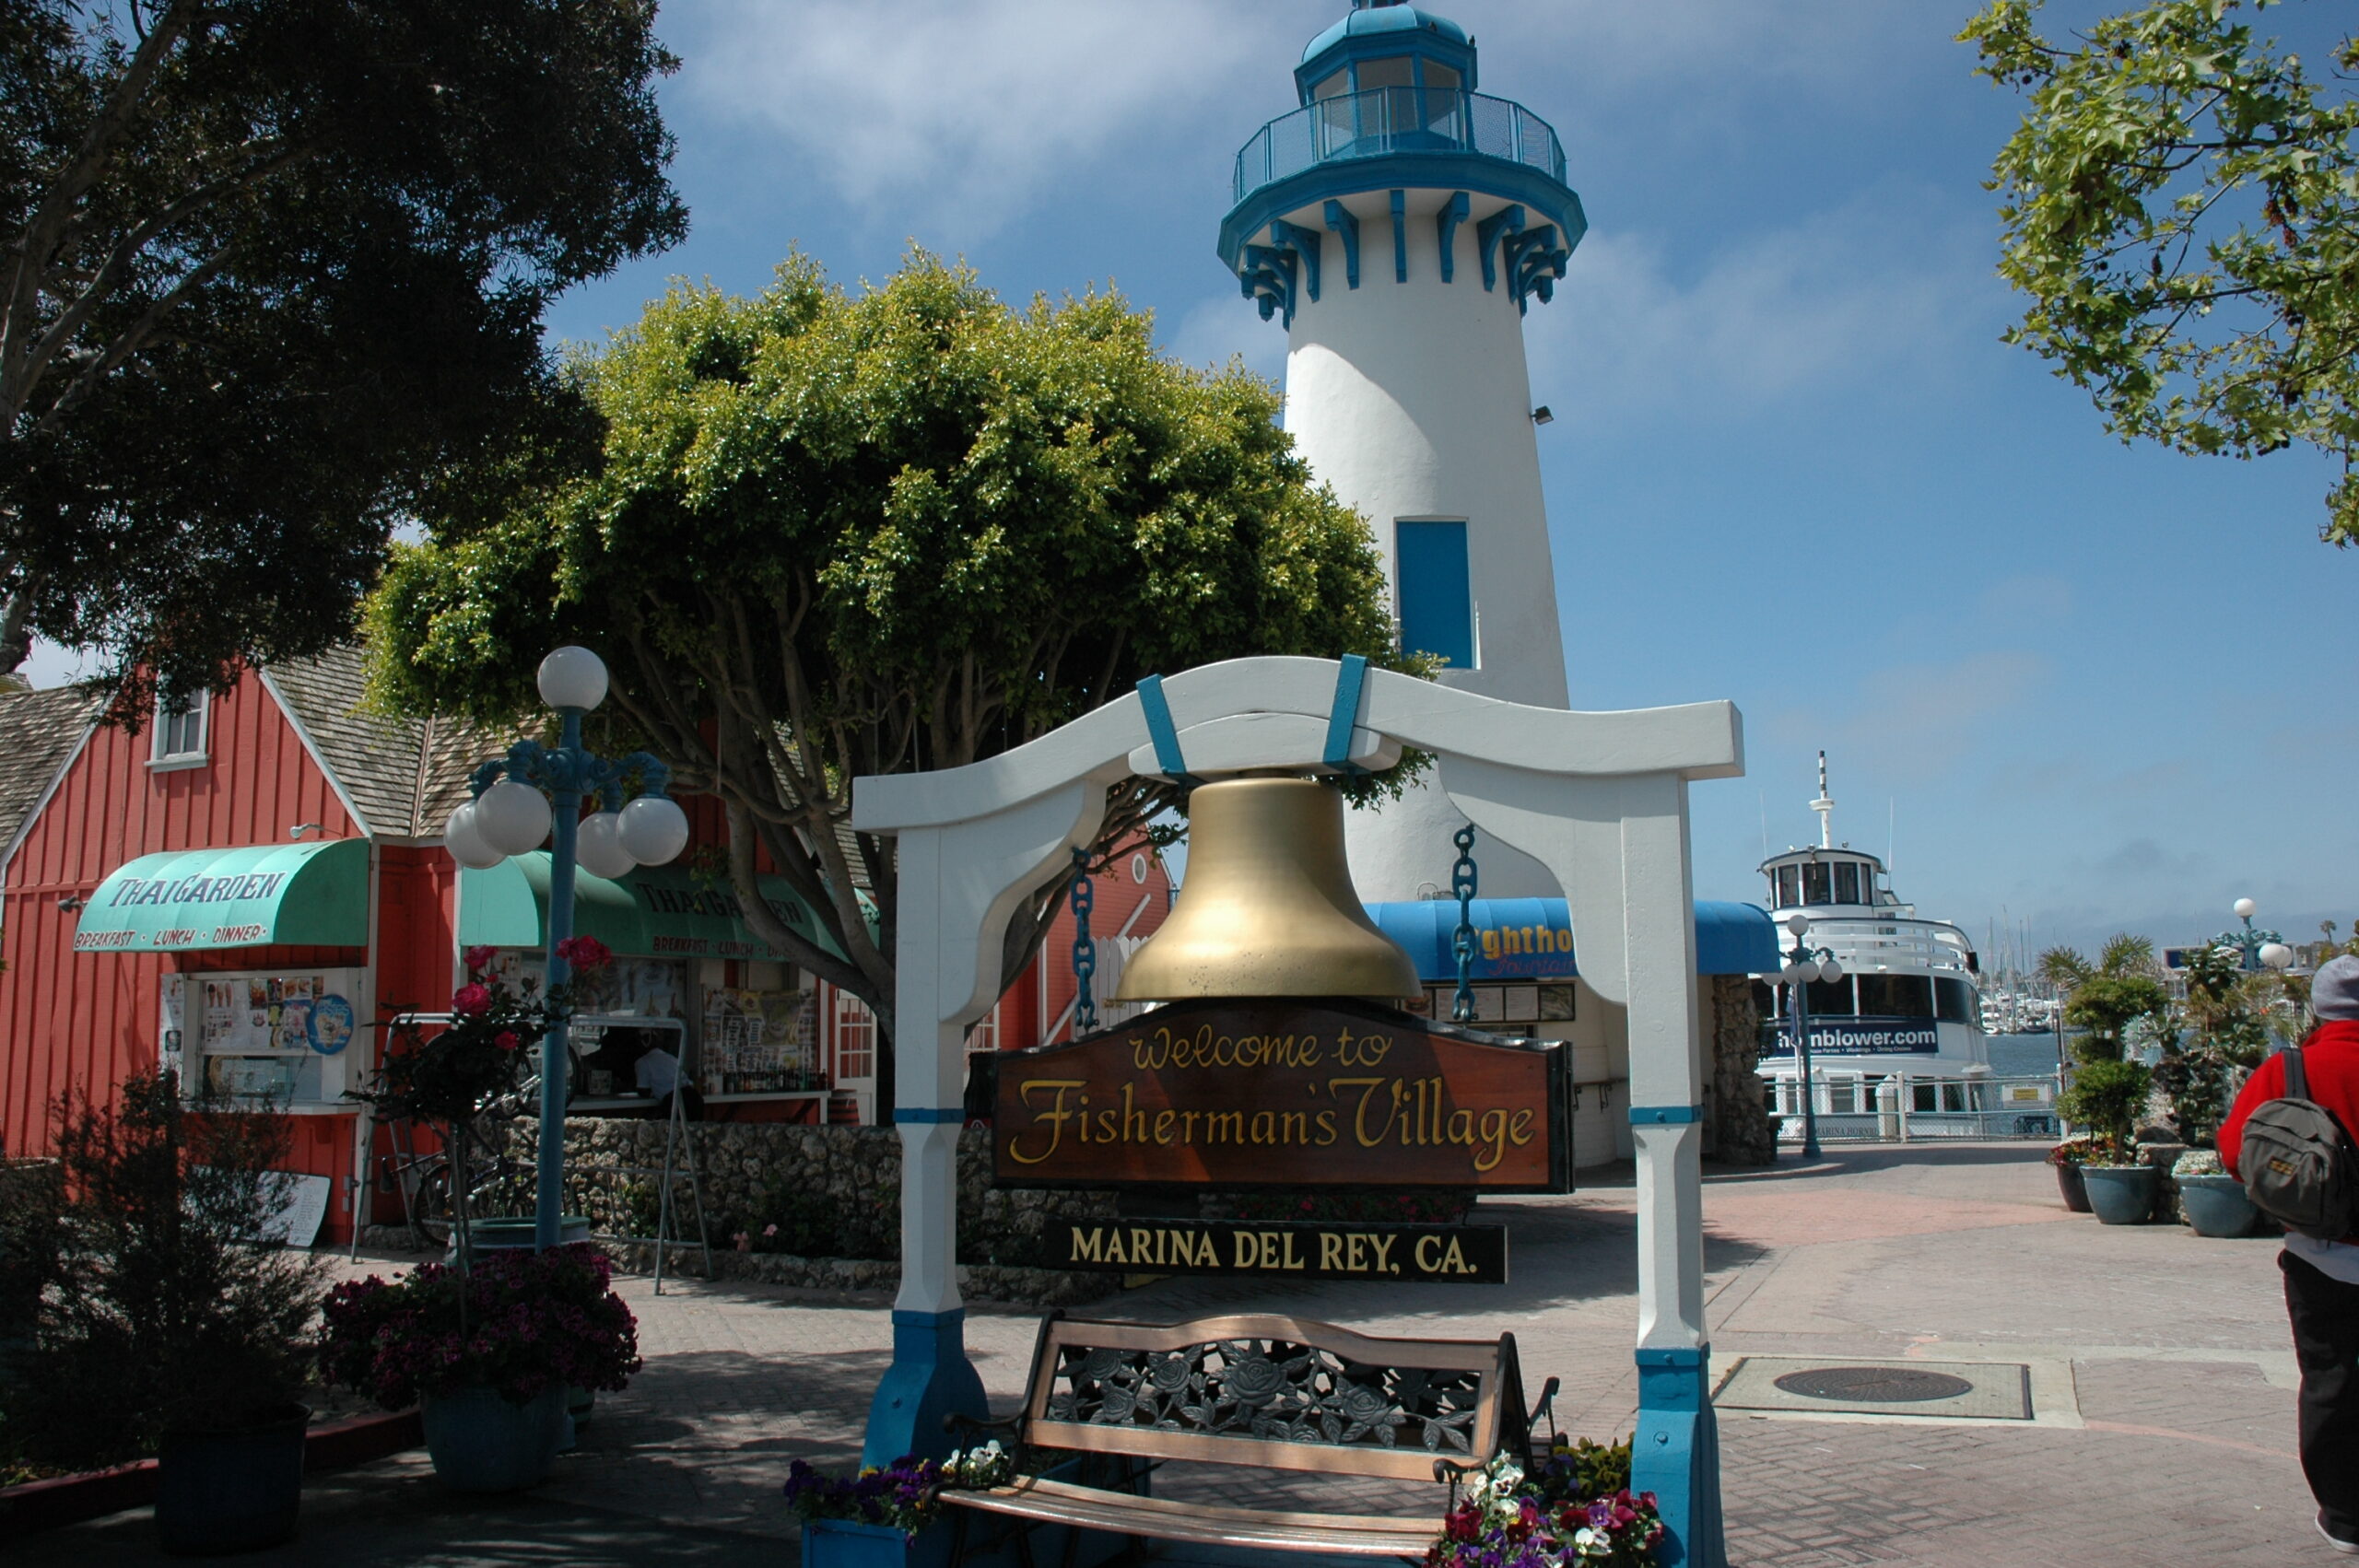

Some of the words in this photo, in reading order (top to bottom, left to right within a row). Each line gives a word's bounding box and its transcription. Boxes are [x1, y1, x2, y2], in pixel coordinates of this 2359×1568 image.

[74, 930, 136, 949] BREAKFAST
[152, 929, 196, 946] LUNCH
[212, 924, 262, 943] DINNER
[652, 936, 709, 954] BREAKFAST
[718, 941, 754, 957] LUNCH
[1458, 925, 1572, 960] ghtho
[1129, 1024, 1322, 1069] Welcome
[1331, 1026, 1392, 1067] to
[1778, 1028, 1936, 1048] honblower.com
[1009, 1079, 1337, 1164] Fisherman's
[1328, 1076, 1534, 1172] Village
[1070, 1226, 1220, 1268] MARINA
[1233, 1231, 1305, 1270] DEL
[1320, 1233, 1400, 1275] REY,
[1414, 1235, 1478, 1274] CA.
